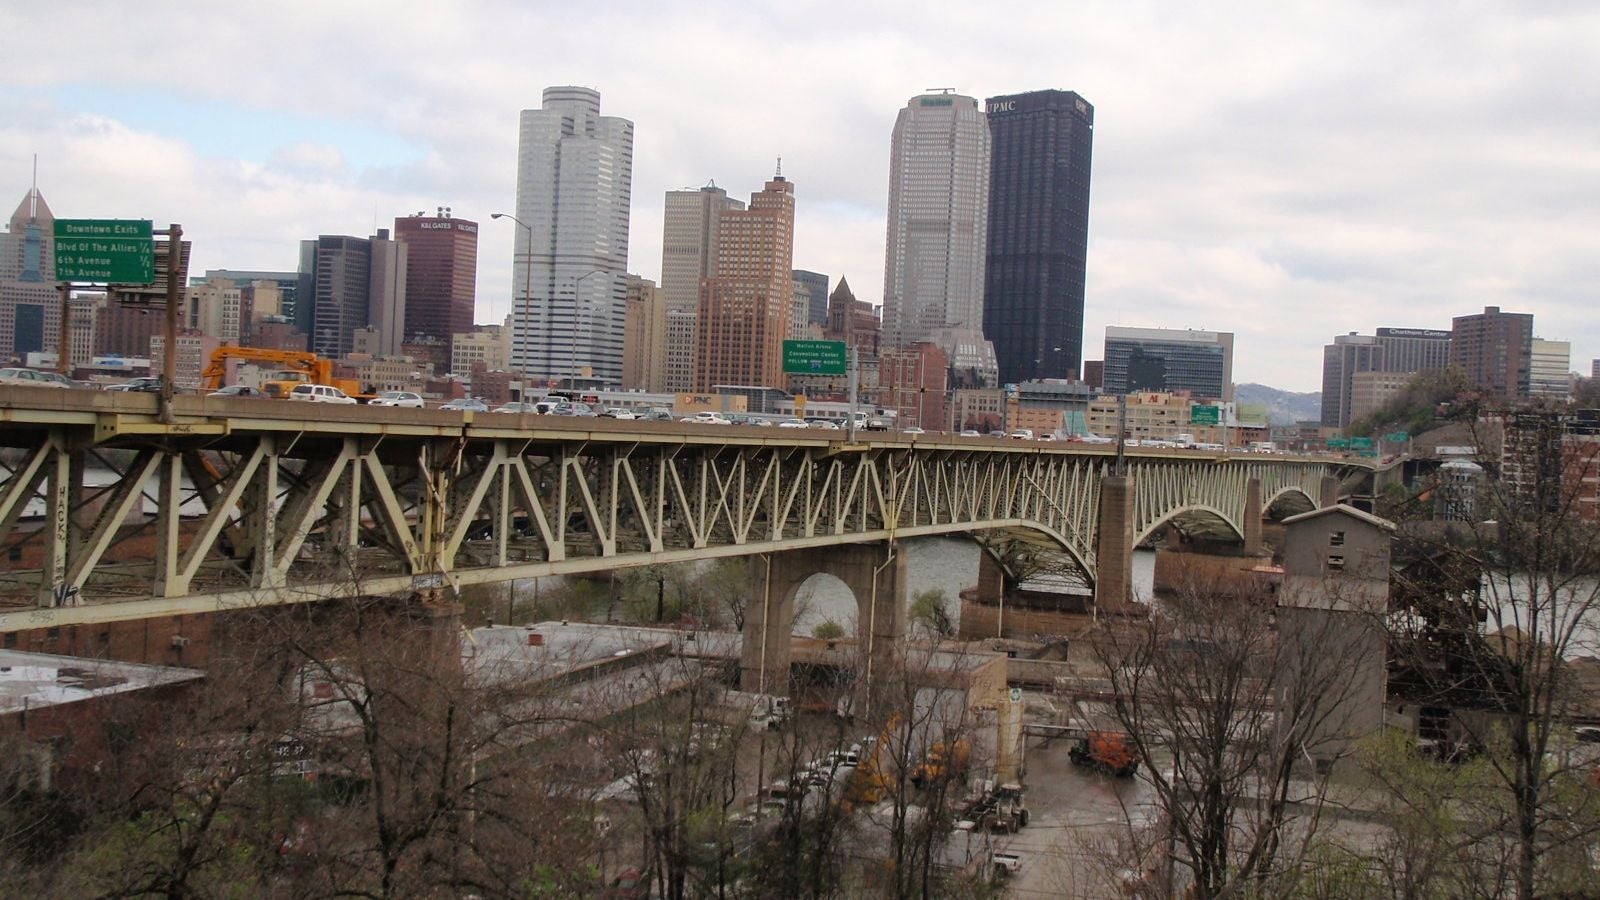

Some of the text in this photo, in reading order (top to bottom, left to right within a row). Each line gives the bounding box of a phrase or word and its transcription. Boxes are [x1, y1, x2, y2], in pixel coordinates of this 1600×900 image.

[986, 100, 1016, 113] UPMC
[66, 224, 138, 234] Downtown Exits
[57, 243, 77, 251] Blvd
[80, 243, 89, 251] Of
[92, 243, 108, 251] The
[110, 244, 137, 253] Allies
[57, 256, 74, 264] 6th
[79, 256, 112, 265] Avenue
[58, 268, 75, 276] 7th
[79, 268, 112, 277] Avenue
[693, 396, 711, 405] PNC
